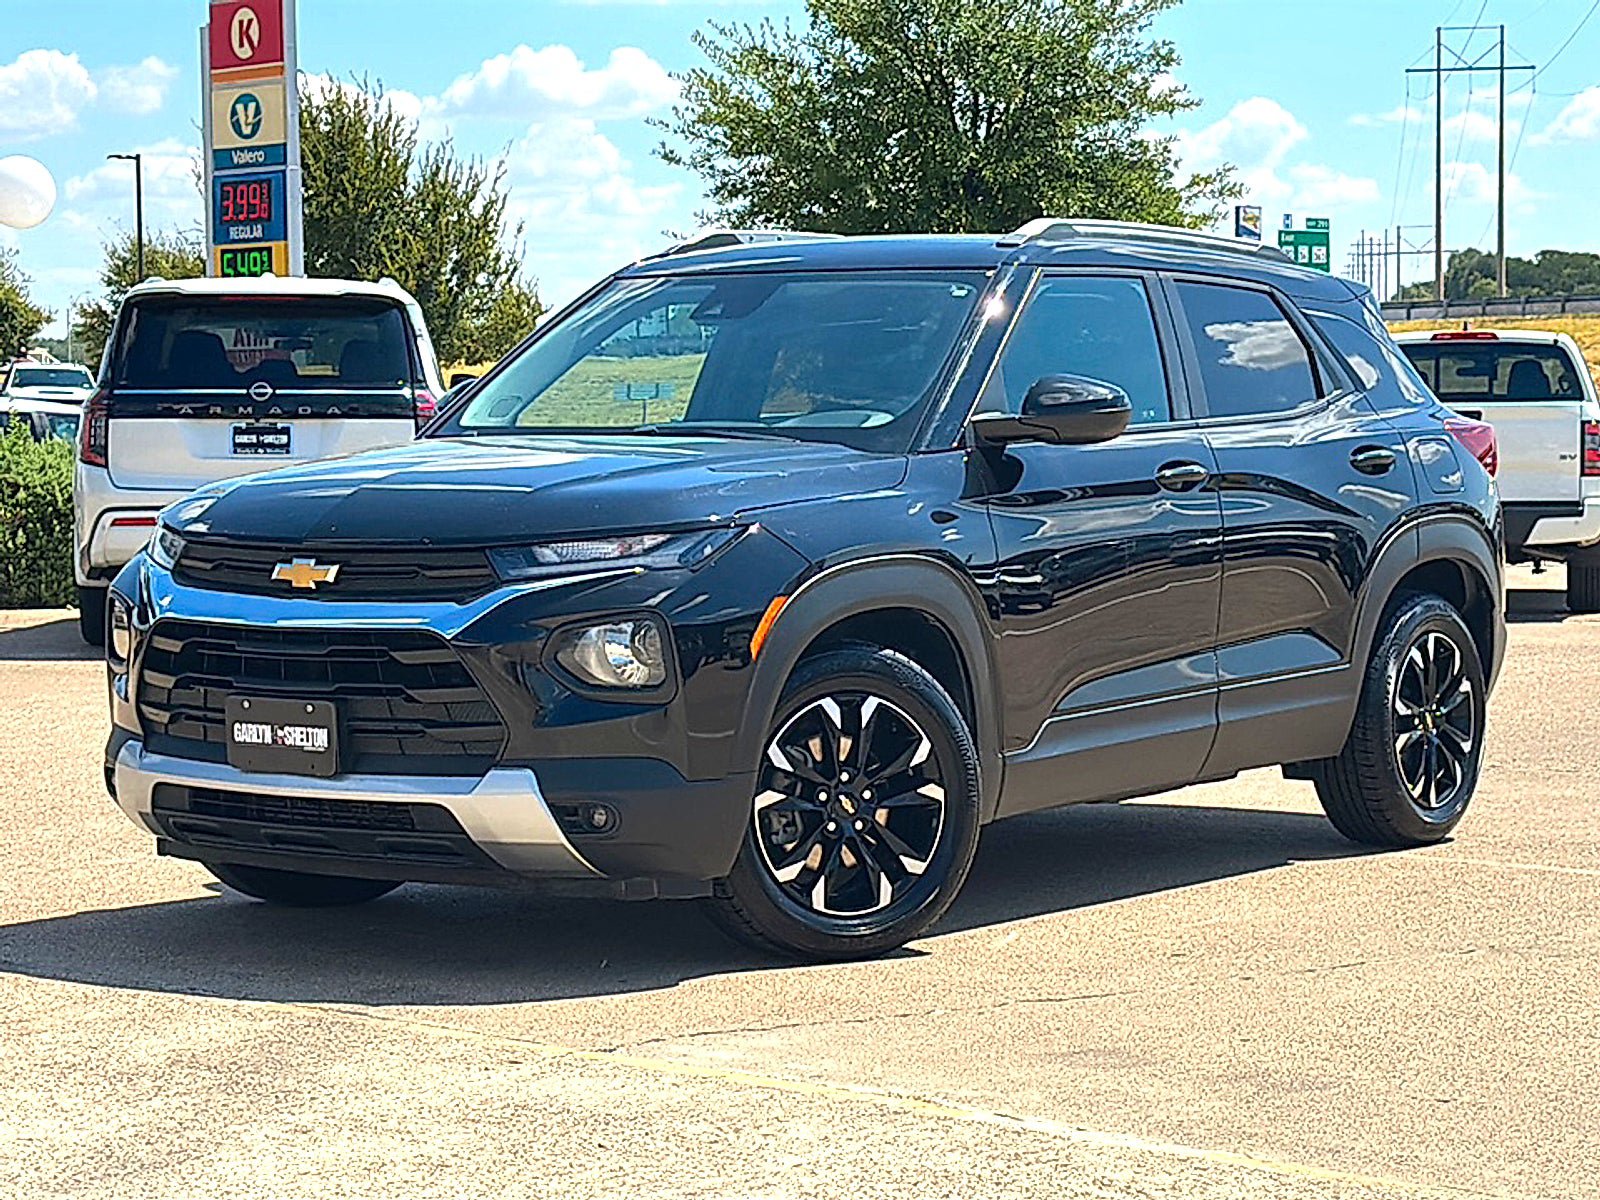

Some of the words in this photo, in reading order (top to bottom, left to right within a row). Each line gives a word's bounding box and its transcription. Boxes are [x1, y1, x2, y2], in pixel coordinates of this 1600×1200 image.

[231, 149, 265, 165] Valero
[228, 224, 264, 240] REGULAR
[179, 406, 342, 415] ARMADA
[284, 726, 328, 748] SHELTON
